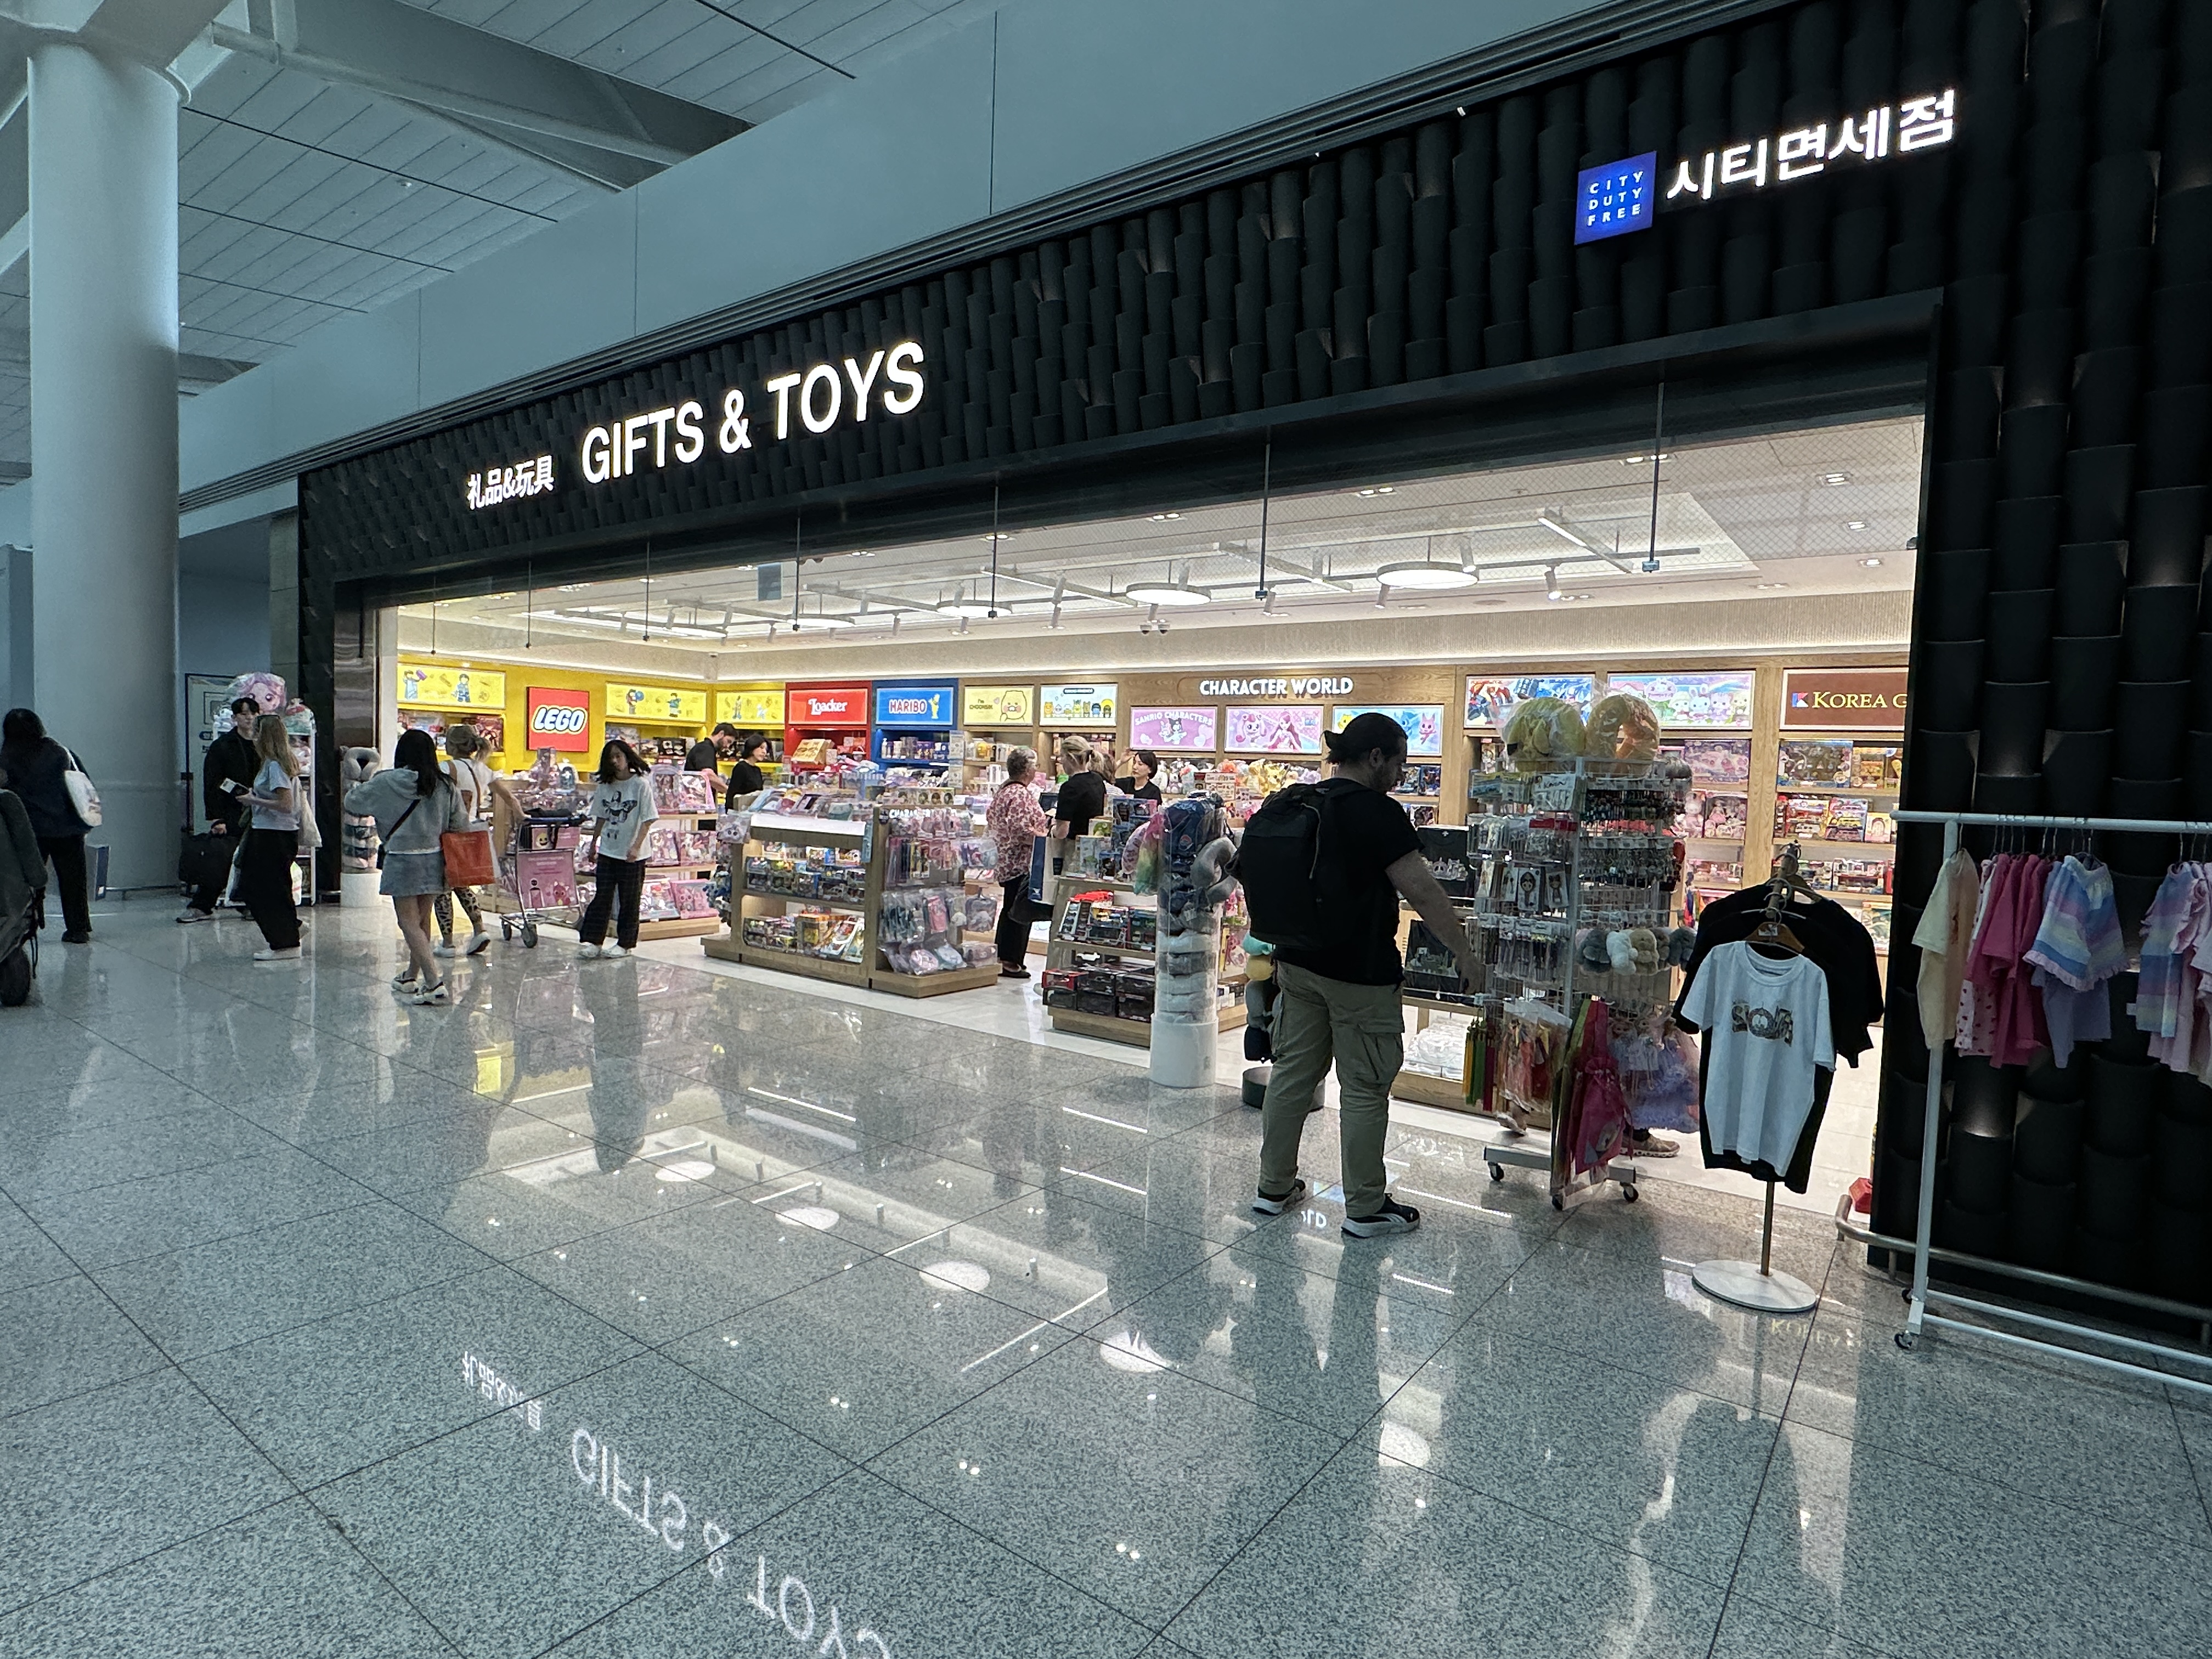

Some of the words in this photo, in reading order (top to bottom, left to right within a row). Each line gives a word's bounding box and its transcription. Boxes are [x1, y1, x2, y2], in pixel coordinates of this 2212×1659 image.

[1666, 89, 1956, 200] 시티면세점
[1589, 171, 1643, 194] CITY
[1589, 187, 1642, 210] DUTY
[1587, 204, 1640, 226] FREE
[582, 400, 704, 484] GIFTS
[719, 388, 752, 454] &
[766, 340, 926, 440] TOYS
[466, 455, 555, 510] 礼品&玩具
[1199, 679, 1287, 696] CHARACTER
[1291, 676, 1353, 695] WORLD
[809, 698, 847, 715] Loacker
[889, 699, 927, 714] HARIBO
[1812, 691, 1888, 708] KOREA
[534, 707, 585, 732] LEGO
[1135, 712, 1163, 725] SANRIO
[1164, 711, 1213, 725] CHARACTERS
